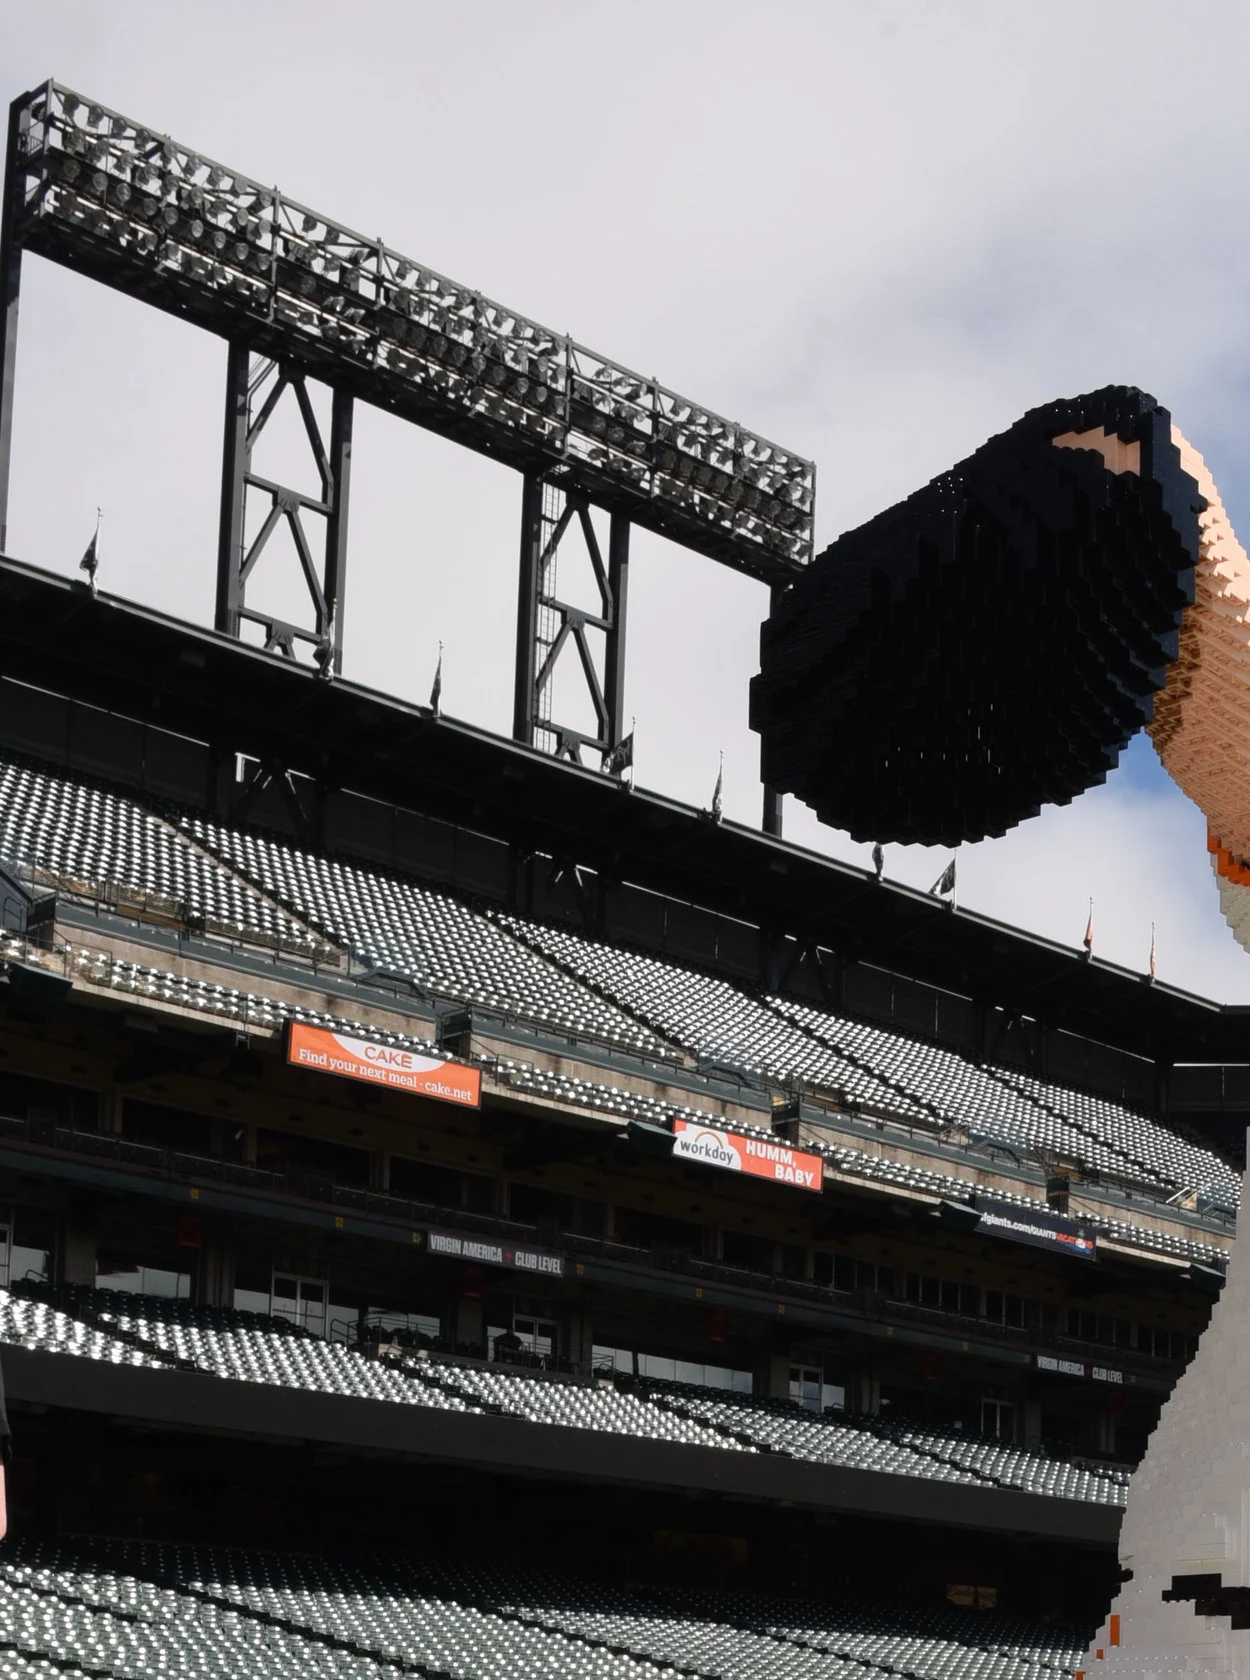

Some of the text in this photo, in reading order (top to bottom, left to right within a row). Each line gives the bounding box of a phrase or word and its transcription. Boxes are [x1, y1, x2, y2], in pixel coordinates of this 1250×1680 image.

[364, 1046, 413, 1069] CAKE
[299, 1048, 327, 1066] Find
[329, 1056, 357, 1073] your
[359, 1065, 386, 1081] next
[388, 1072, 417, 1088] meal
[425, 1080, 472, 1101] cake.net
[680, 1140, 734, 1166] workday
[745, 1139, 796, 1168] HUMM,
[774, 1164, 815, 1187] BABY
[430, 1234, 562, 1274] VIRGIN AMERICA CLUB LEVEL
